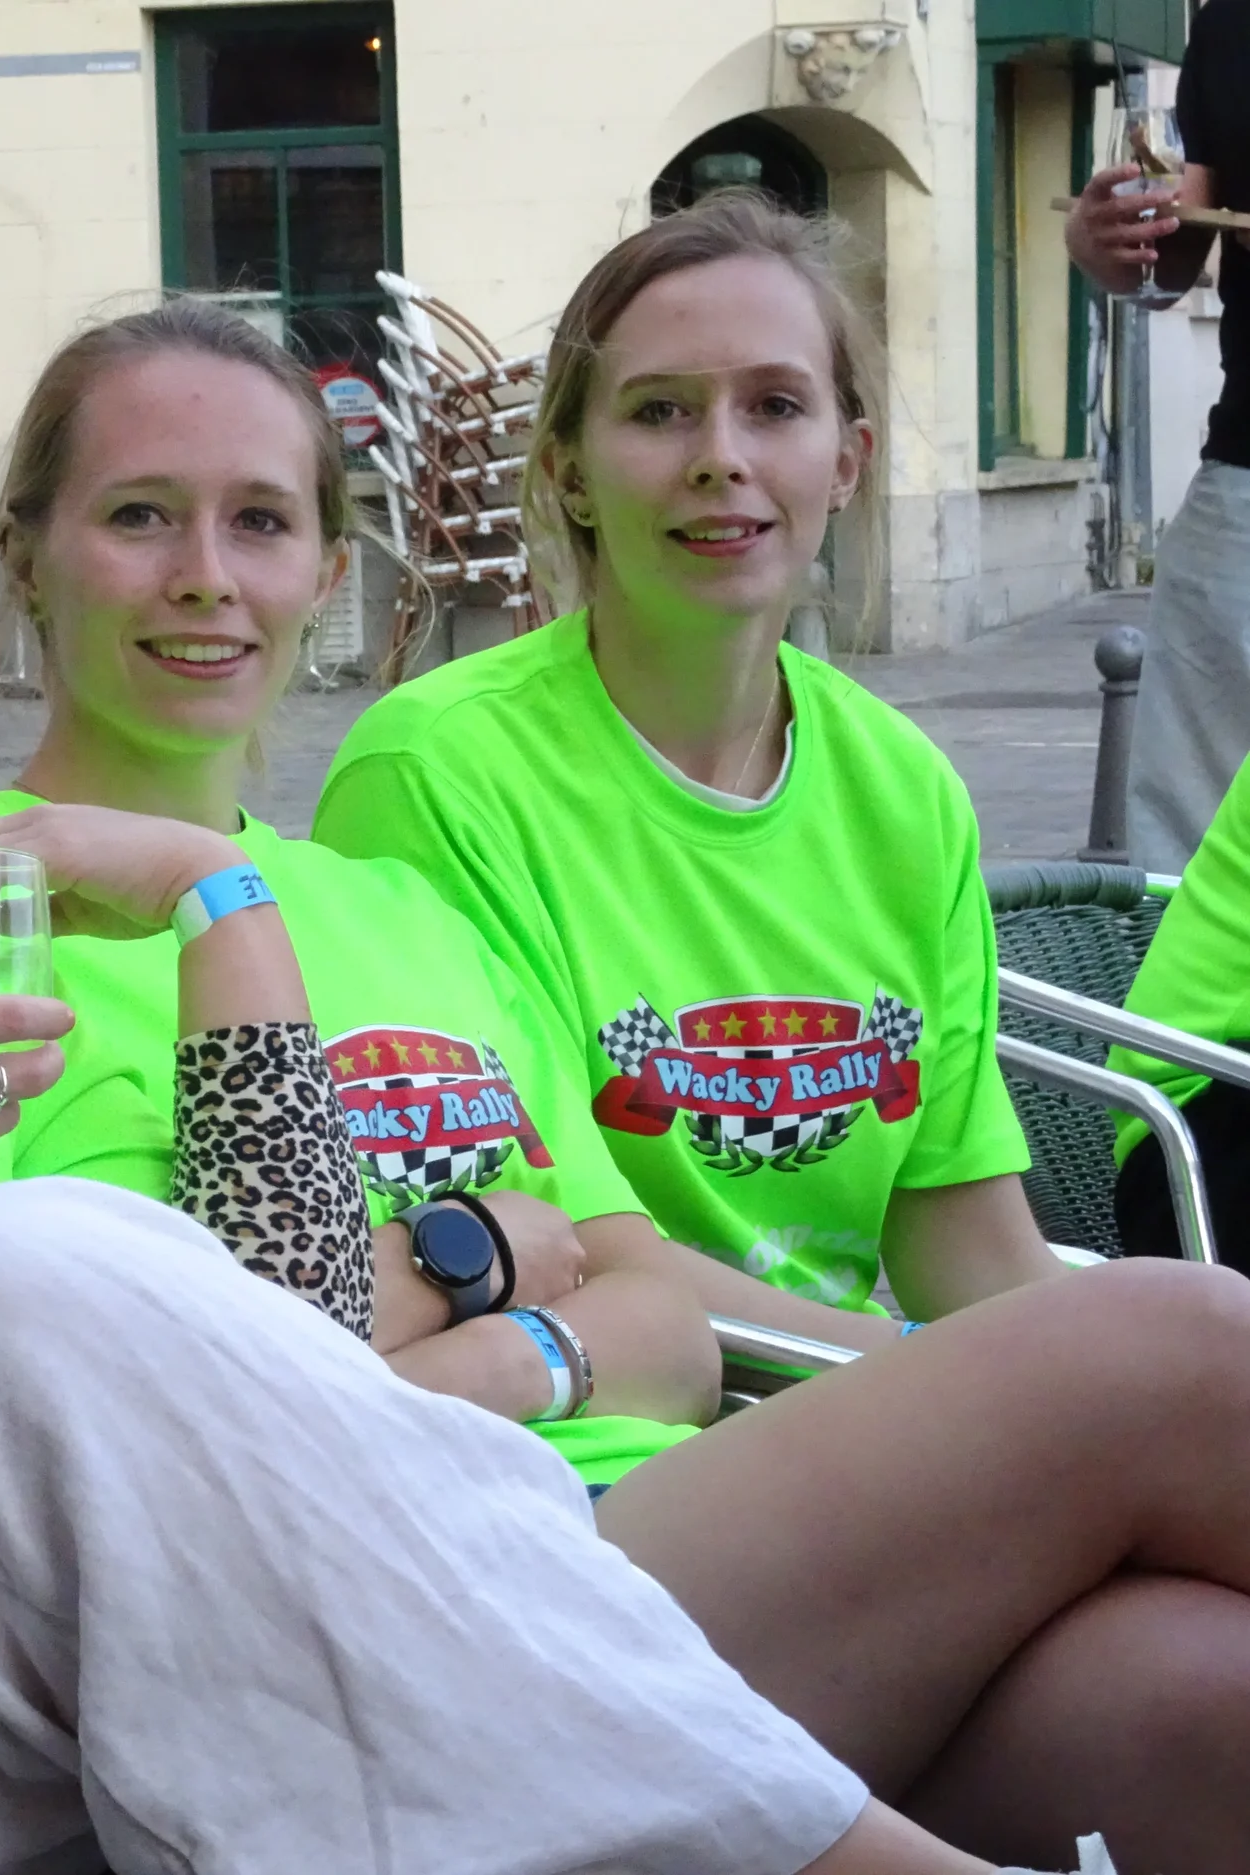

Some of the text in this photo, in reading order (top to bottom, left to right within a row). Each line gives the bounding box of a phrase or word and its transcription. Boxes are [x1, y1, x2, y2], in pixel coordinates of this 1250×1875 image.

[653, 1050, 882, 1112] Wacky Rally
[344, 1085, 520, 1143] acky Rally
